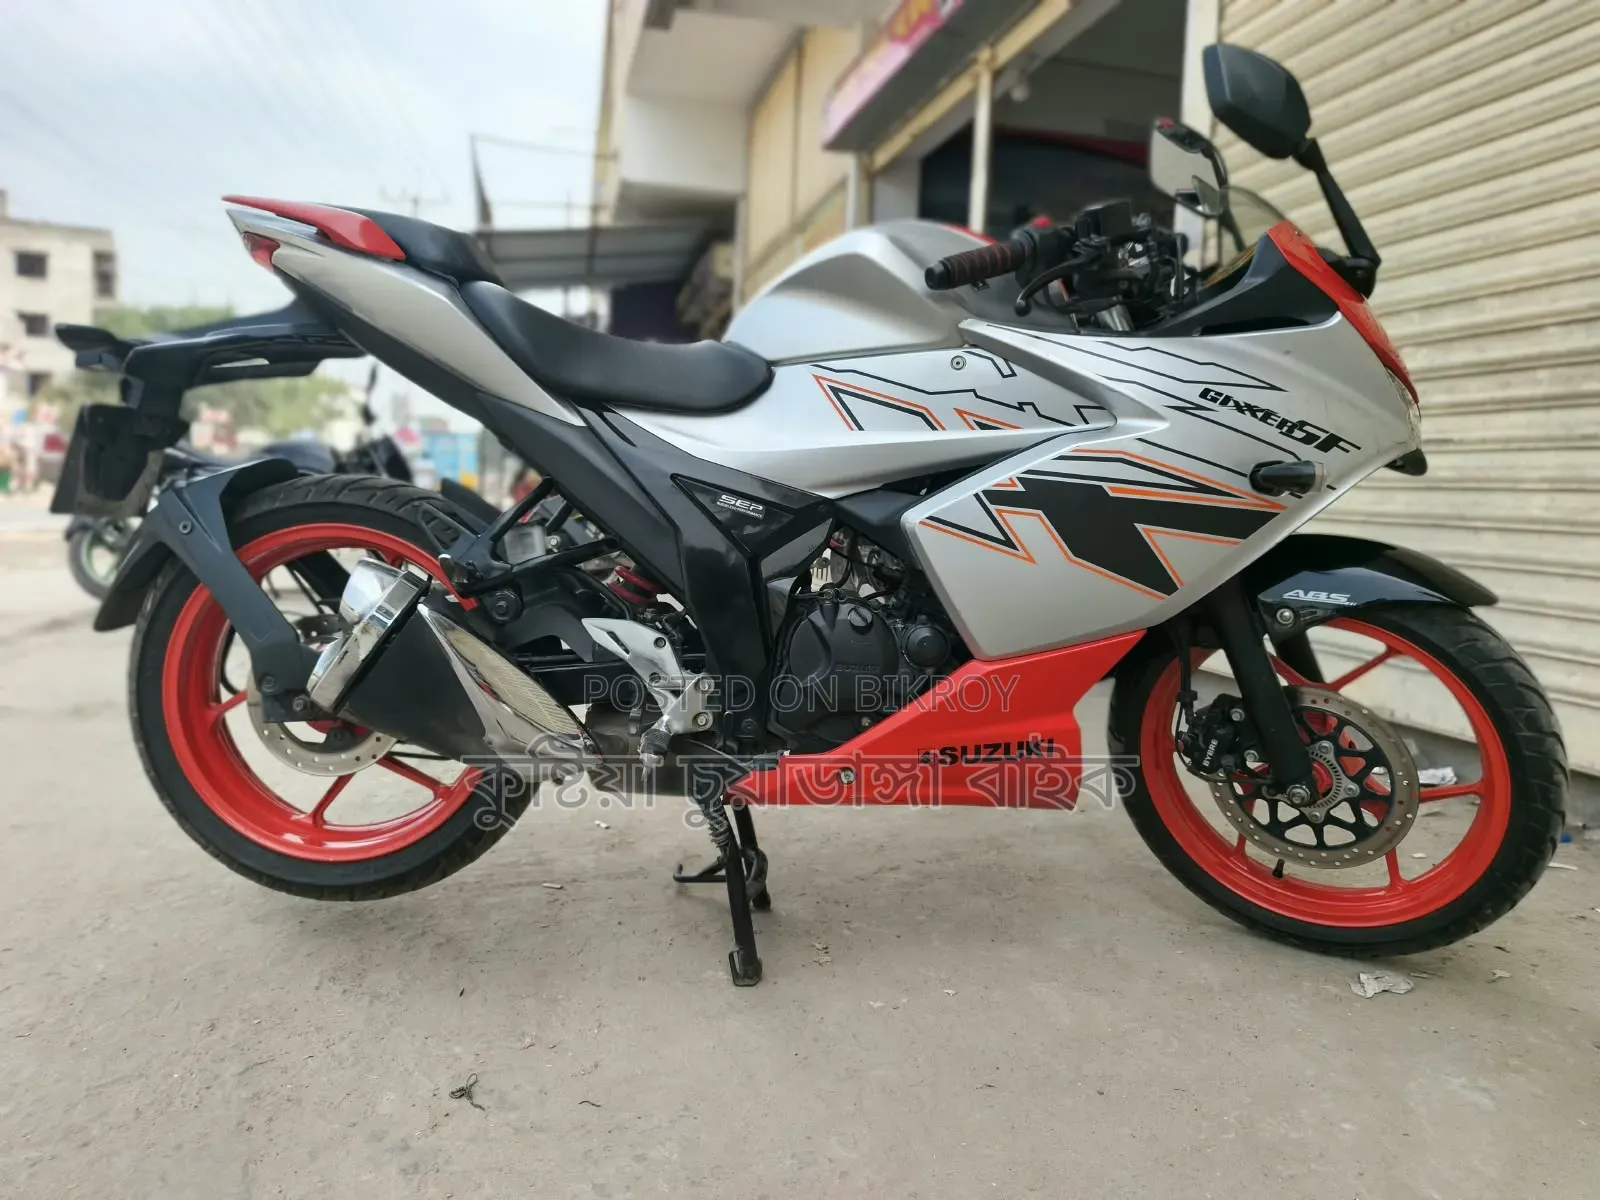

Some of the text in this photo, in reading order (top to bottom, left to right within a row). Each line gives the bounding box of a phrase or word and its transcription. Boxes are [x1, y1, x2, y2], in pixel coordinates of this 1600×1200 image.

[719, 494, 763, 511] SEP
[1282, 589, 1352, 603] ABS
[939, 738, 1054, 765] SUZUKI
[1202, 738, 1218, 767] BYBRE
